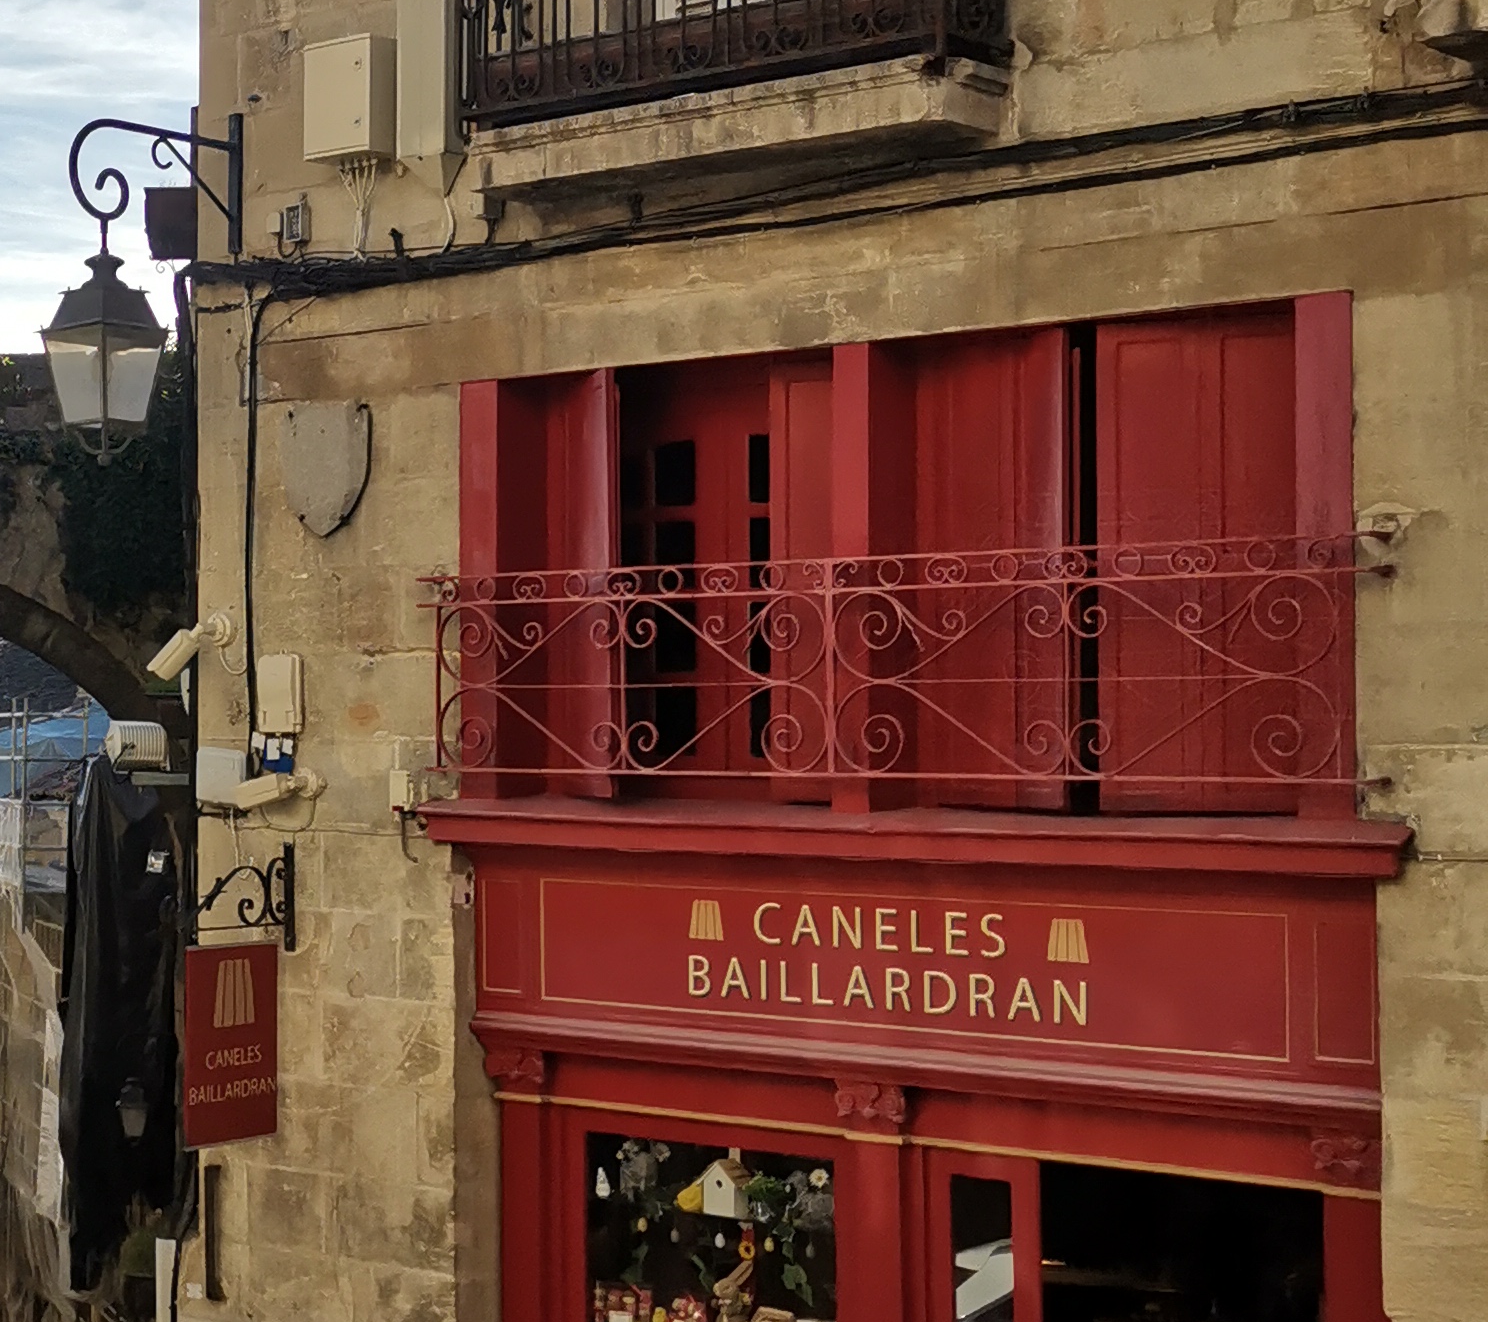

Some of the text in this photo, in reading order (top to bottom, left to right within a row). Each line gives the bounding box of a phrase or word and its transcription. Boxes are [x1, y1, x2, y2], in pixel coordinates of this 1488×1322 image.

[752, 900, 1008, 960] CANELES
[686, 954, 1089, 1026] BAILLARDRAN
[205, 1043, 263, 1070] CANELES
[188, 1076, 276, 1106] BAILLARDRAN
